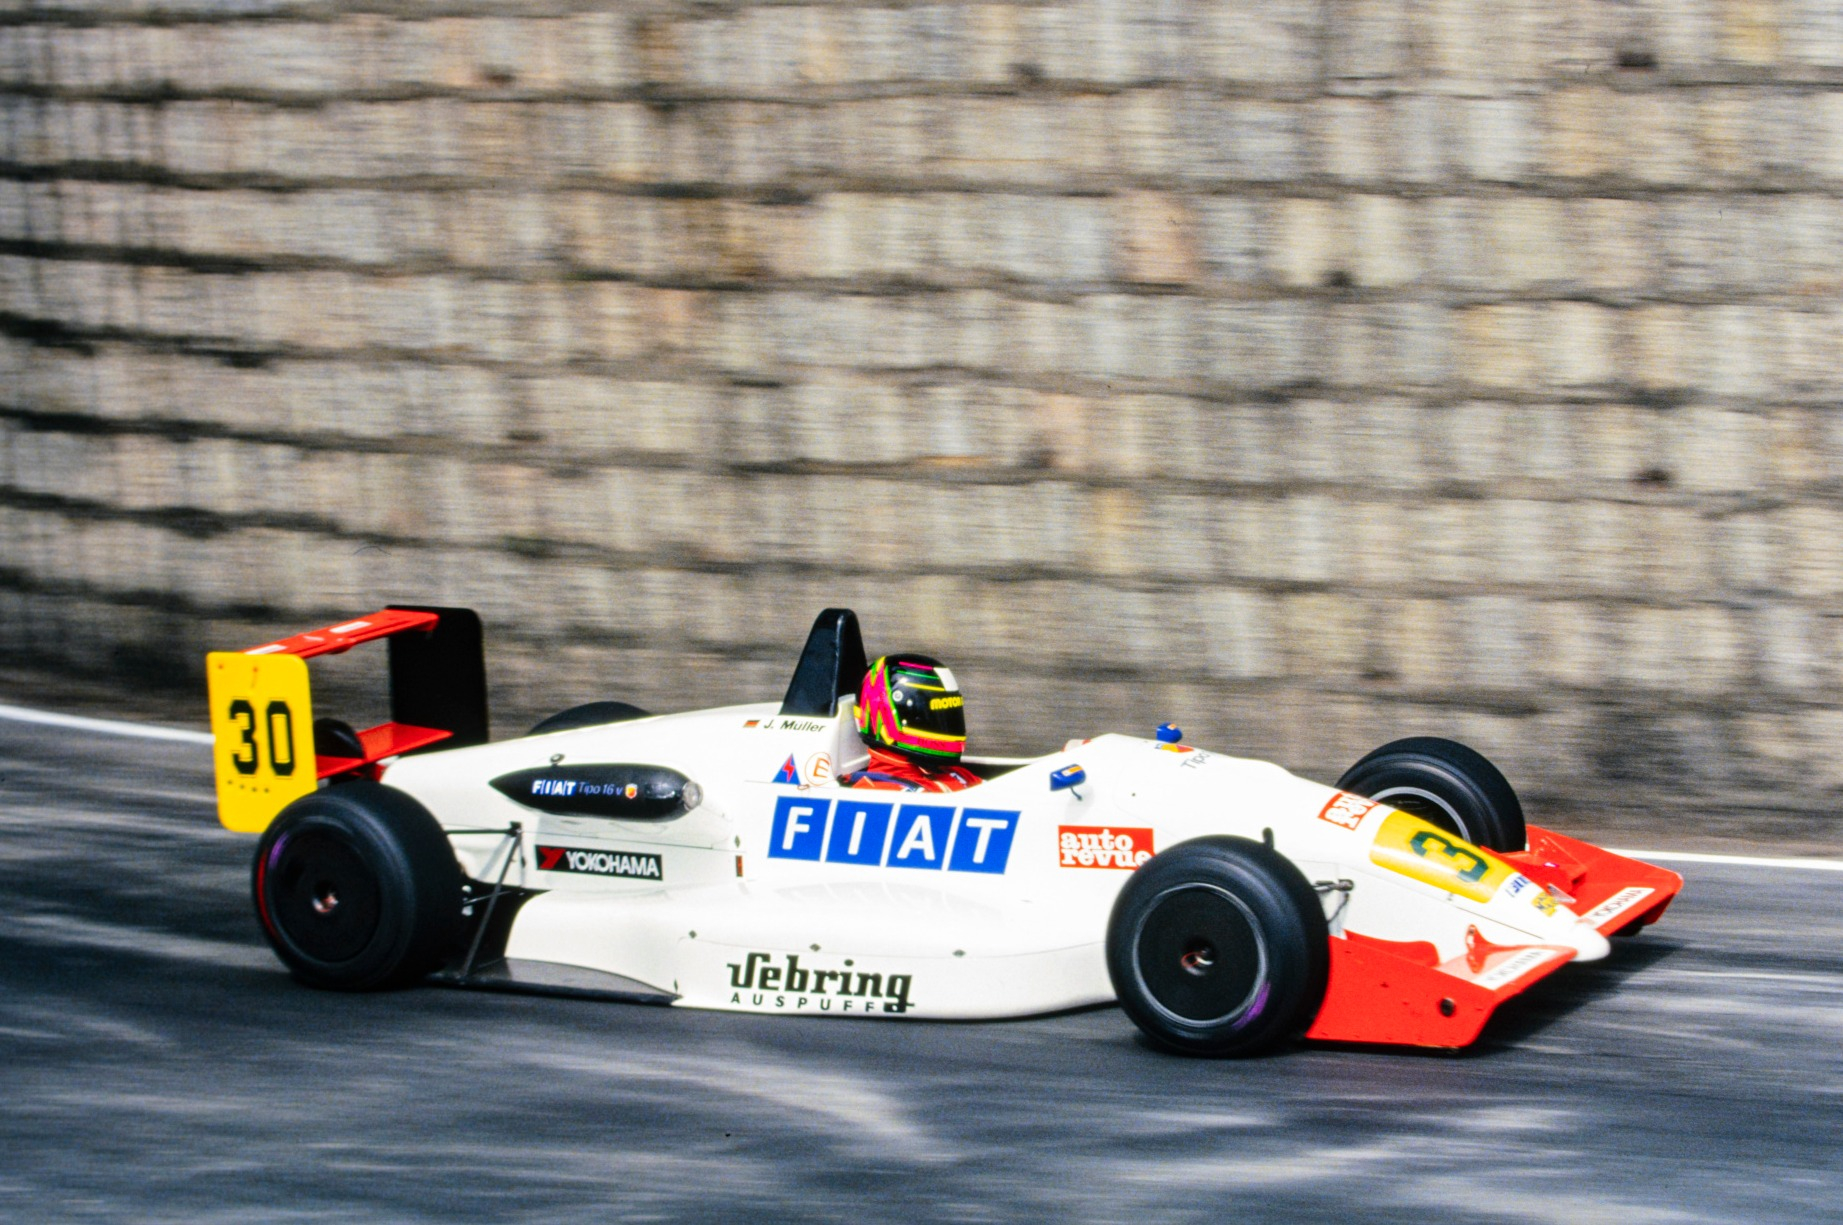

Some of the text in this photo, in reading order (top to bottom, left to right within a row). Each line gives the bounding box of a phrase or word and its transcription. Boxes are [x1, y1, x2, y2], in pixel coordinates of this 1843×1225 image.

[229, 699, 296, 777] 30
[812, 757, 831, 779] E
[532, 780, 577, 796] FIAT
[782, 806, 1008, 864] FIAT
[1060, 828, 1134, 851] auto
[566, 851, 660, 877] YOKOHAMA
[1061, 848, 1152, 867] revue
[1410, 831, 1489, 883] 3
[726, 952, 915, 1013] Sebring
[731, 992, 875, 1013] AUSPUFF
